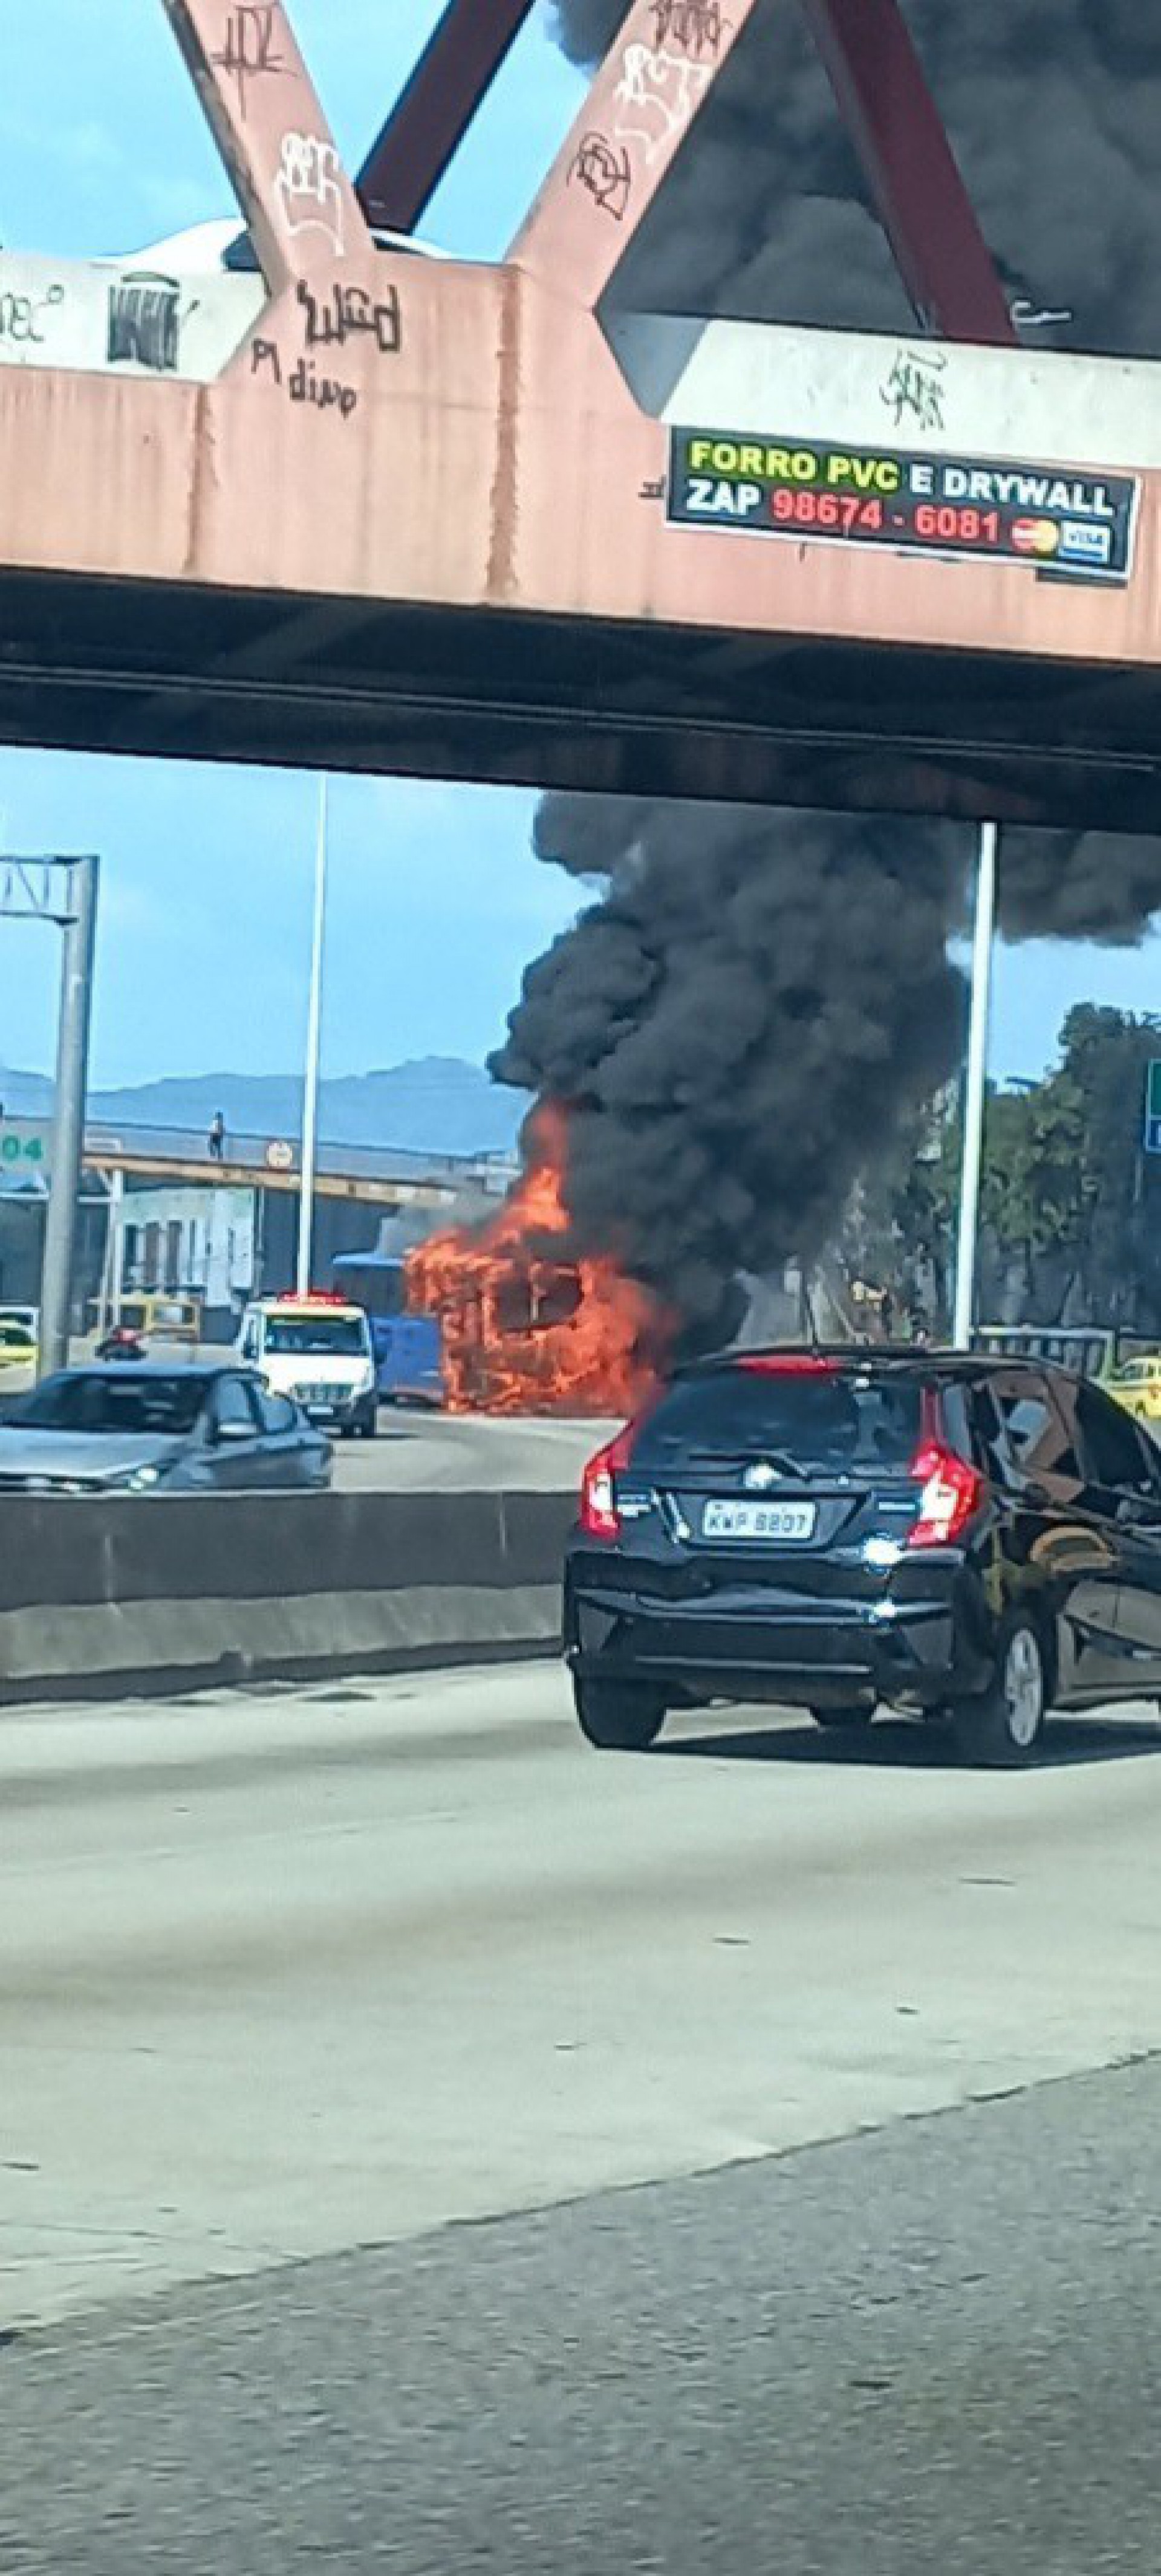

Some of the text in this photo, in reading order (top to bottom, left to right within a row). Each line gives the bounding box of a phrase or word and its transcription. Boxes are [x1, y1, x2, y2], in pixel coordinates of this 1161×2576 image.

[686, 478, 762, 516] ZAP
[772, 488, 883, 530] 98674
[914, 504, 999, 543] 6081
[691, 440, 1115, 516] FORRO PVC E DRYWALL
